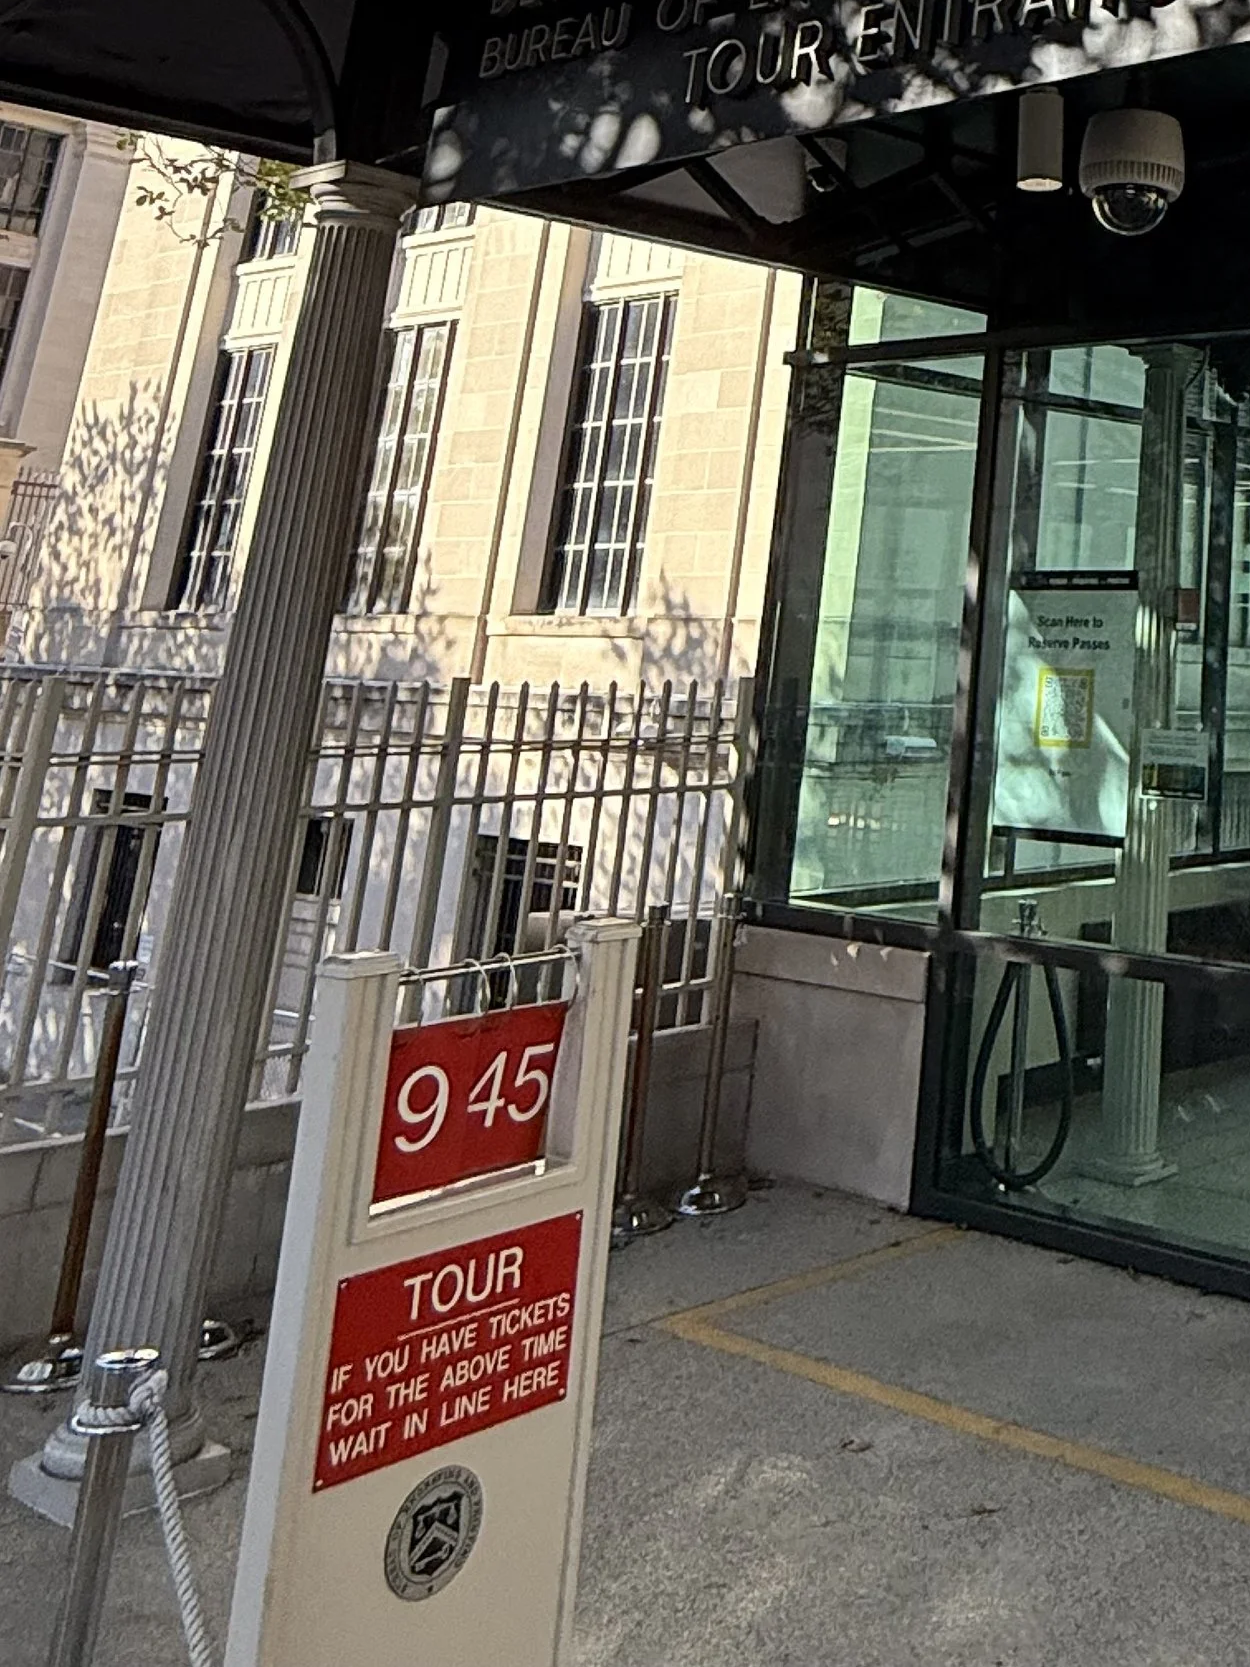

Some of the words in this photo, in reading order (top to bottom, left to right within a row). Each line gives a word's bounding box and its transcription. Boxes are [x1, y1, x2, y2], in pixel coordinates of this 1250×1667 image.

[479, 2, 631, 78] BUREAU
[682, 20, 824, 104] TOUR
[1028, 636, 1070, 650] Reserve
[1072, 637, 1111, 650] Passes
[1037, 615, 1063, 627] Scan
[1065, 616, 1090, 628] Here
[1092, 616, 1103, 628] to
[394, 1065, 450, 1153] 9
[467, 1042, 555, 1128] 45
[403, 1246, 524, 1321] TOUR
[326, 1397, 374, 1431] FOR
[385, 1373, 431, 1410] THE
[439, 1345, 513, 1392] ABOVE
[521, 1325, 569, 1362] TIME
[330, 1363, 353, 1395] IF
[364, 1344, 410, 1382] YOU
[420, 1323, 479, 1364] HAVE
[488, 1292, 571, 1338] TICKETS
[329, 1422, 392, 1467] WAIT
[403, 1409, 429, 1440] IN
[439, 1386, 493, 1427] LINE
[502, 1360, 561, 1403] HERE
